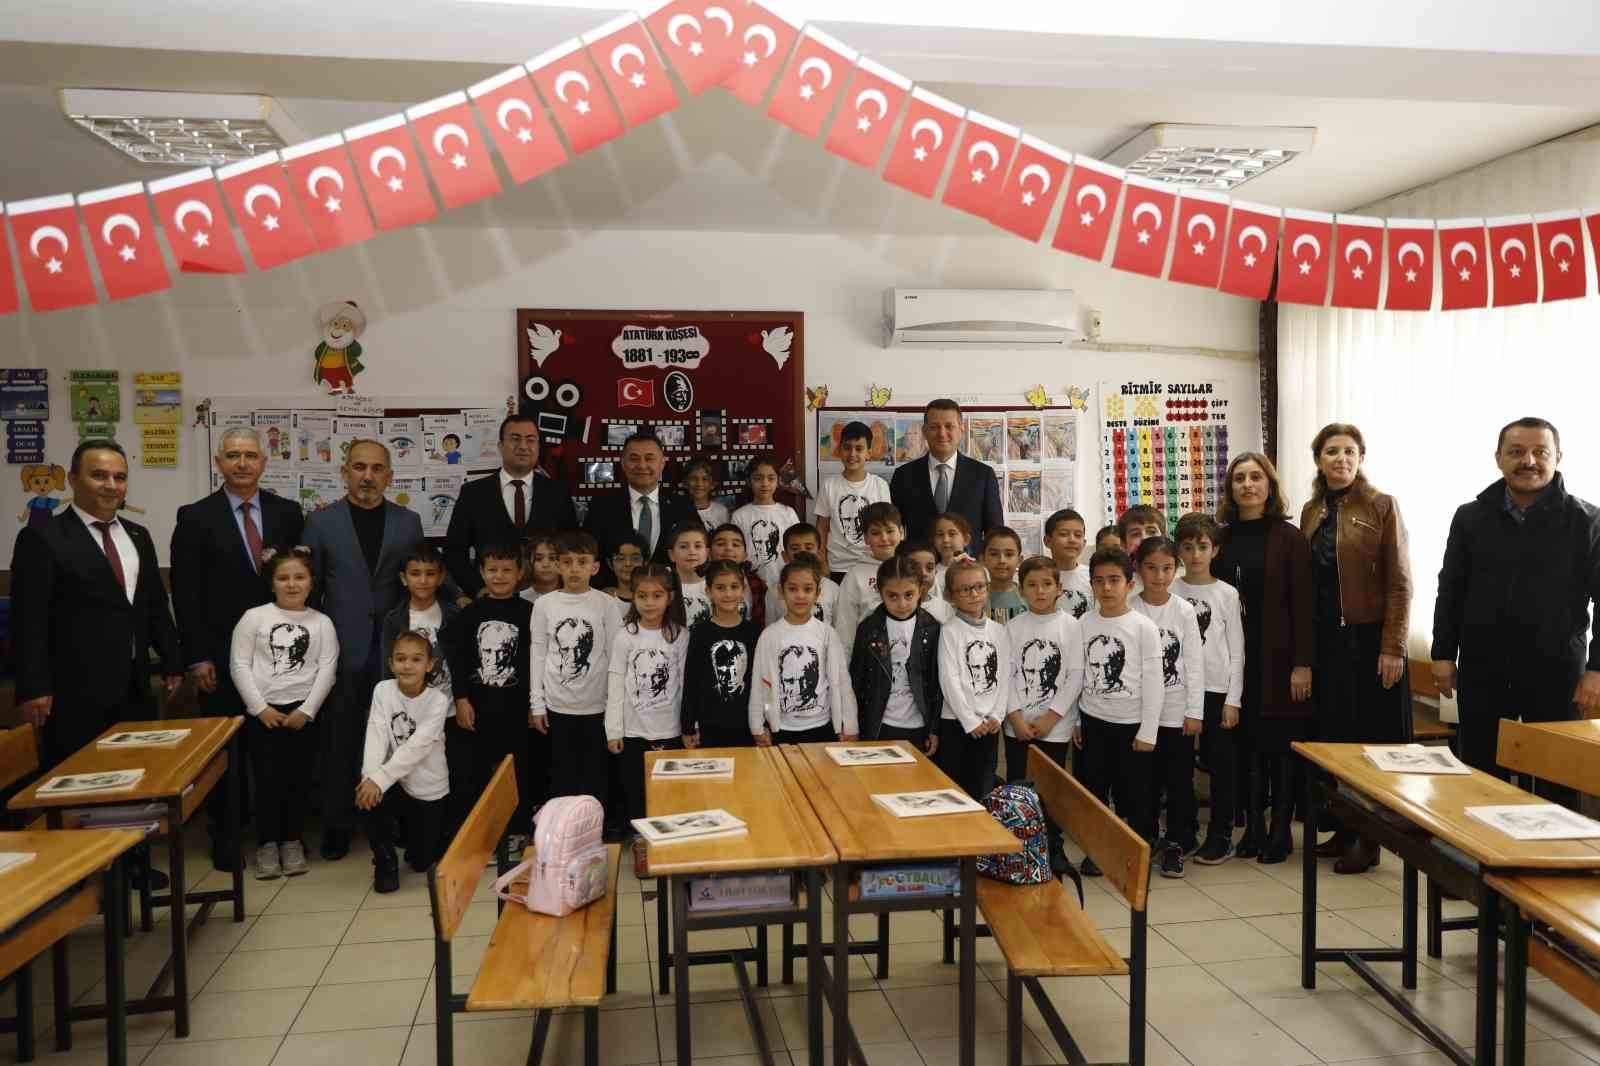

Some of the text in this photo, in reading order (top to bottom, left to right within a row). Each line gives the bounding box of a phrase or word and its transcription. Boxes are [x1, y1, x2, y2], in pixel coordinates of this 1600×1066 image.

[624, 328, 663, 340] ATATÜRK
[623, 348, 653, 362] 1881
[1120, 381, 1213, 395] RİTMİK SAYILAR
